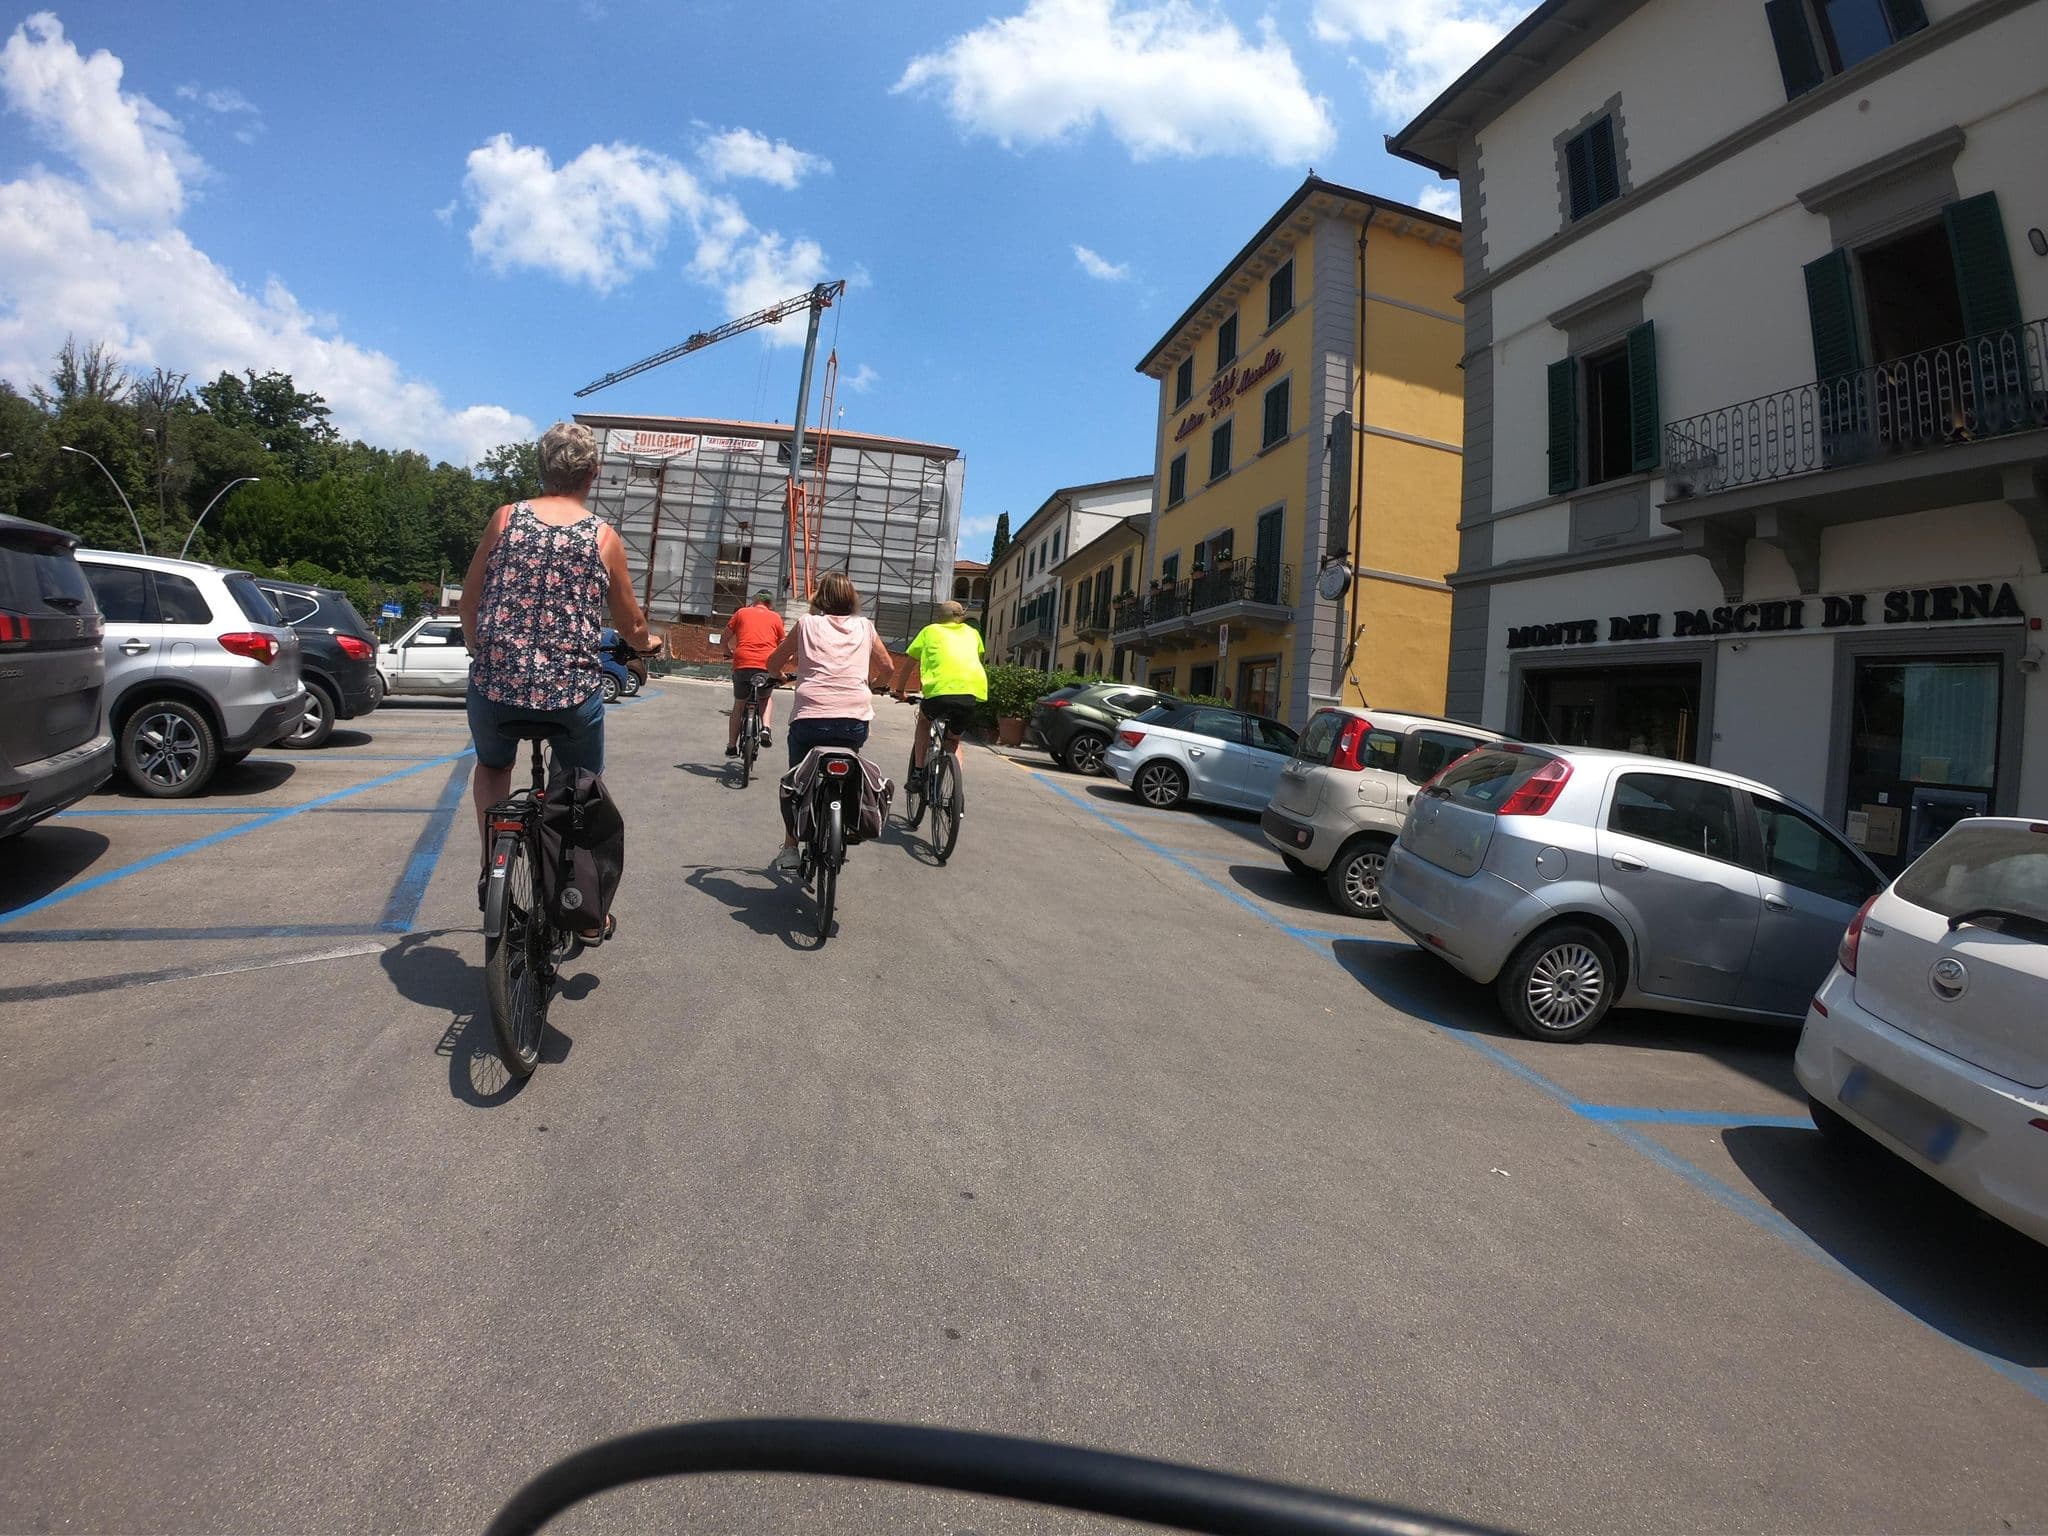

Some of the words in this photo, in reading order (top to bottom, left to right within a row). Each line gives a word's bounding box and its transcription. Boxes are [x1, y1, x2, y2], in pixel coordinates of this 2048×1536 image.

[1507, 619, 1598, 648] MONTE
[1608, 613, 1661, 641] DEI
[1673, 600, 1805, 636] PASCHI
[1822, 595, 1867, 627] DI
[1884, 582, 2025, 623] SIENA
